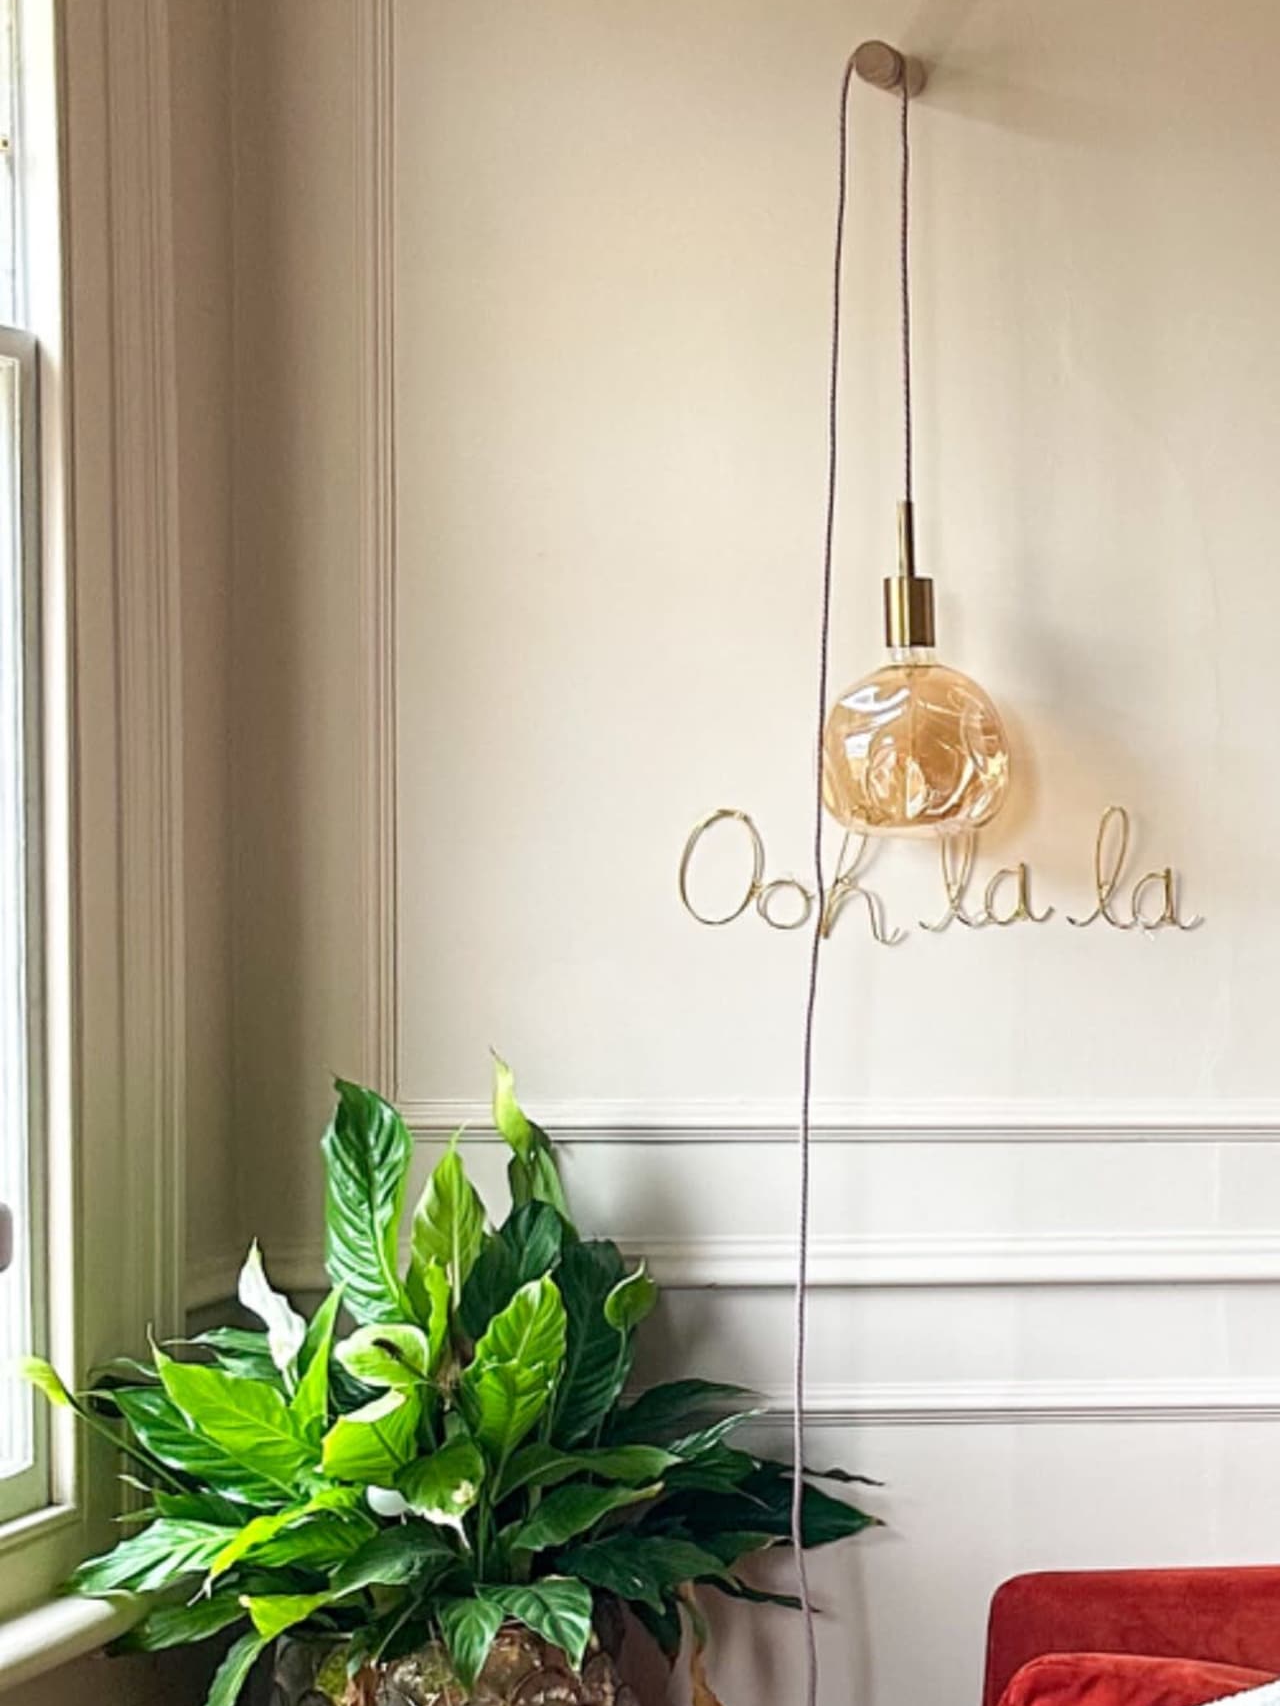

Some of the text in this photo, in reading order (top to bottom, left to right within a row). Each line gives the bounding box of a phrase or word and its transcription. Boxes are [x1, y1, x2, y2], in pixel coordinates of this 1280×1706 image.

[679, 806, 1205, 945] Ooh la la
